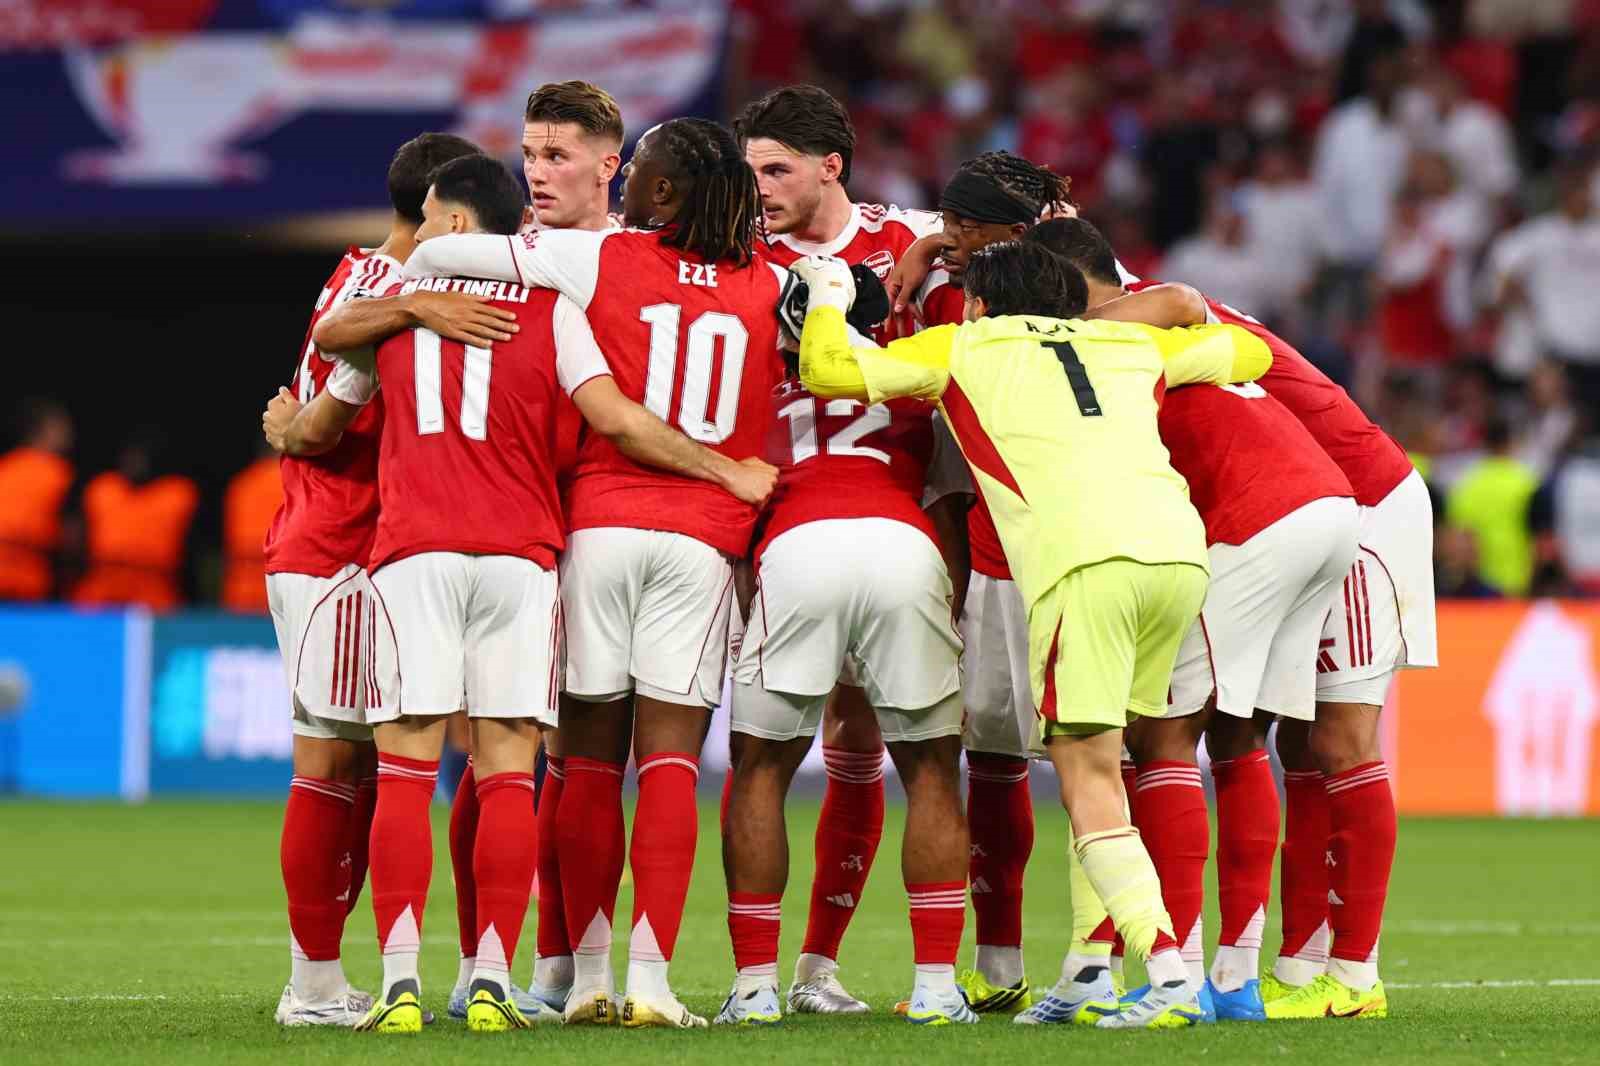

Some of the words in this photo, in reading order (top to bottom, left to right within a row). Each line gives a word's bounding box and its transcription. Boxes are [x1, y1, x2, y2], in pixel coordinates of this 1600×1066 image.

[399, 277, 530, 304] MARTINELLI
[678, 259, 718, 288] EZE
[414, 326, 493, 441] 11
[640, 302, 750, 445] 10
[1040, 340, 1103, 417] 1
[777, 396, 893, 466] 12
